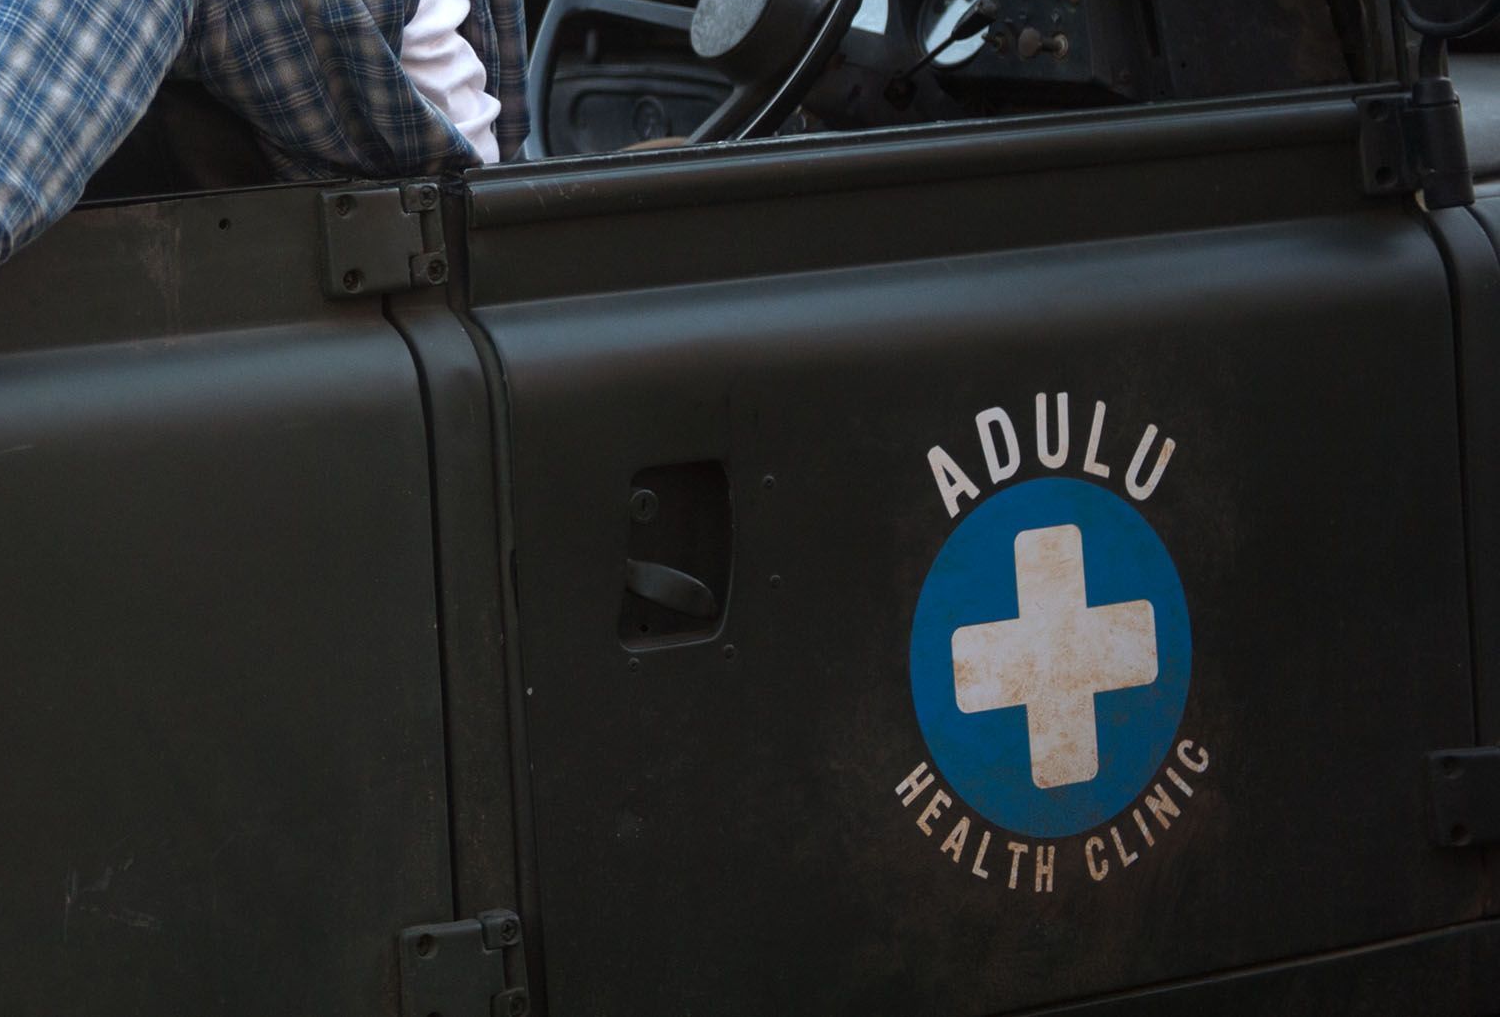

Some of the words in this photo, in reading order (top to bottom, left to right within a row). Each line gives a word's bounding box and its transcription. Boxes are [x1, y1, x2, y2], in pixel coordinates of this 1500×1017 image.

[927, 392, 1176, 518] ADULU
[895, 761, 1055, 893] HEALTH
[1085, 738, 1210, 881] CLINIC
